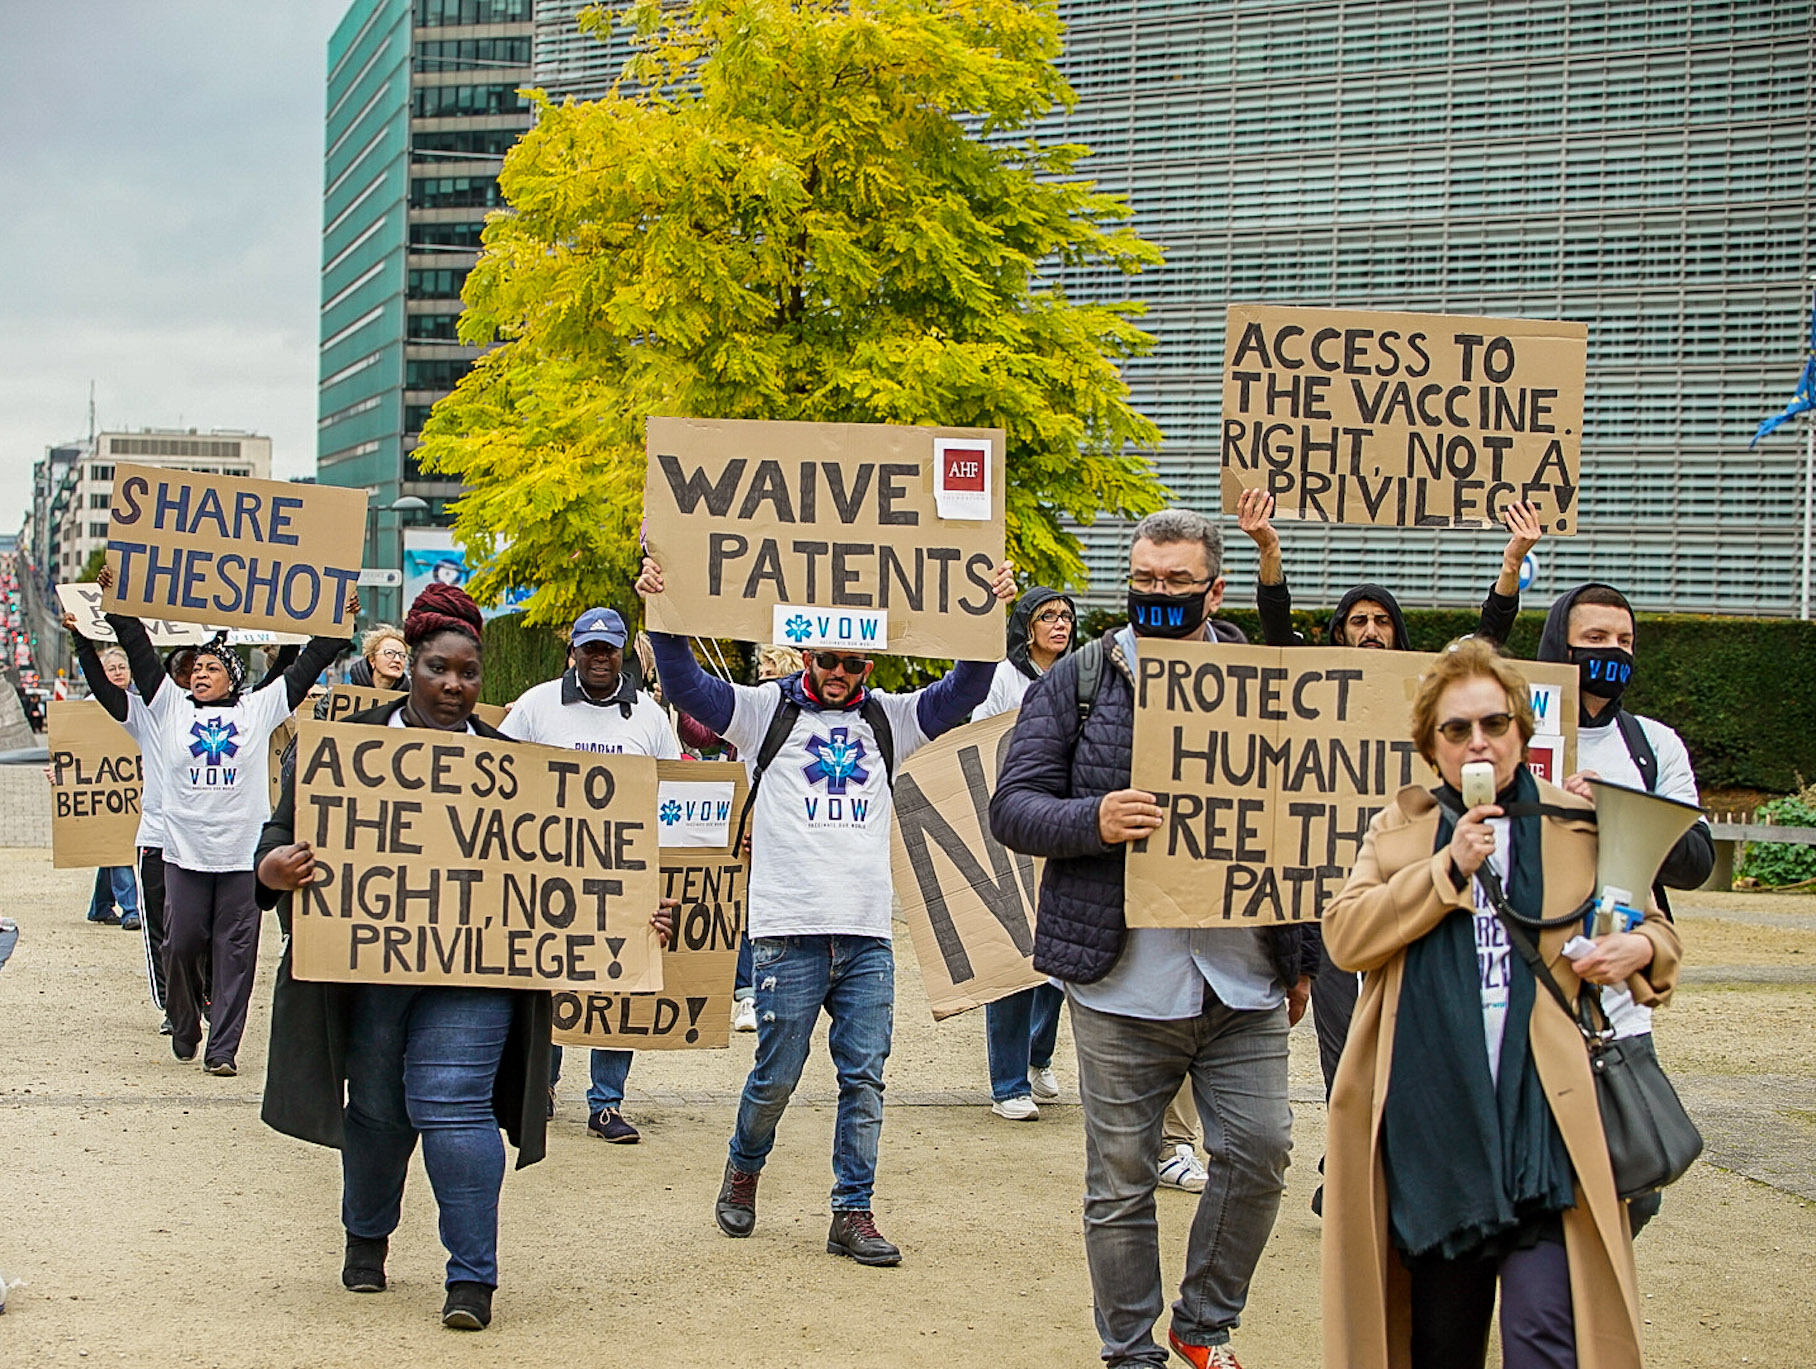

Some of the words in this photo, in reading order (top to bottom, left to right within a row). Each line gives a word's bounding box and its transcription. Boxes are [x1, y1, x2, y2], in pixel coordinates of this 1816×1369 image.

[1231, 322, 1430, 378] ACCESS
[1453, 333, 1515, 384] TO
[1232, 371, 1332, 420] THE
[948, 460, 978, 478] AHF
[1221, 419, 1380, 477] RIGHT,
[1407, 430, 1514, 482] NOT
[1530, 439, 1571, 487] A
[111, 476, 304, 546] SHARE
[657, 454, 920, 527] WAIVE
[709, 533, 998, 616] PATENTS
[817, 616, 878, 641] VOW
[1135, 606, 1184, 627] VOW
[1138, 656, 1363, 722] PROTECT
[1589, 659, 1631, 684] VOW
[190, 767, 237, 785] VOW
[301, 736, 519, 801] ACCESS
[548, 760, 616, 810] TO
[1172, 726, 1418, 796] HUMANIT
[56, 788, 143, 818] BEFOR
[309, 793, 423, 855] THE
[446, 804, 647, 871] VACCINE
[686, 800, 730, 821] VOW
[804, 797, 868, 822] VOW
[502, 873, 624, 932] NOT
[659, 864, 743, 904] TENT
[1223, 863, 1353, 921] PATE
[350, 923, 627, 981] PRIVILEGE!
[551, 992, 708, 1044] ORLD!
